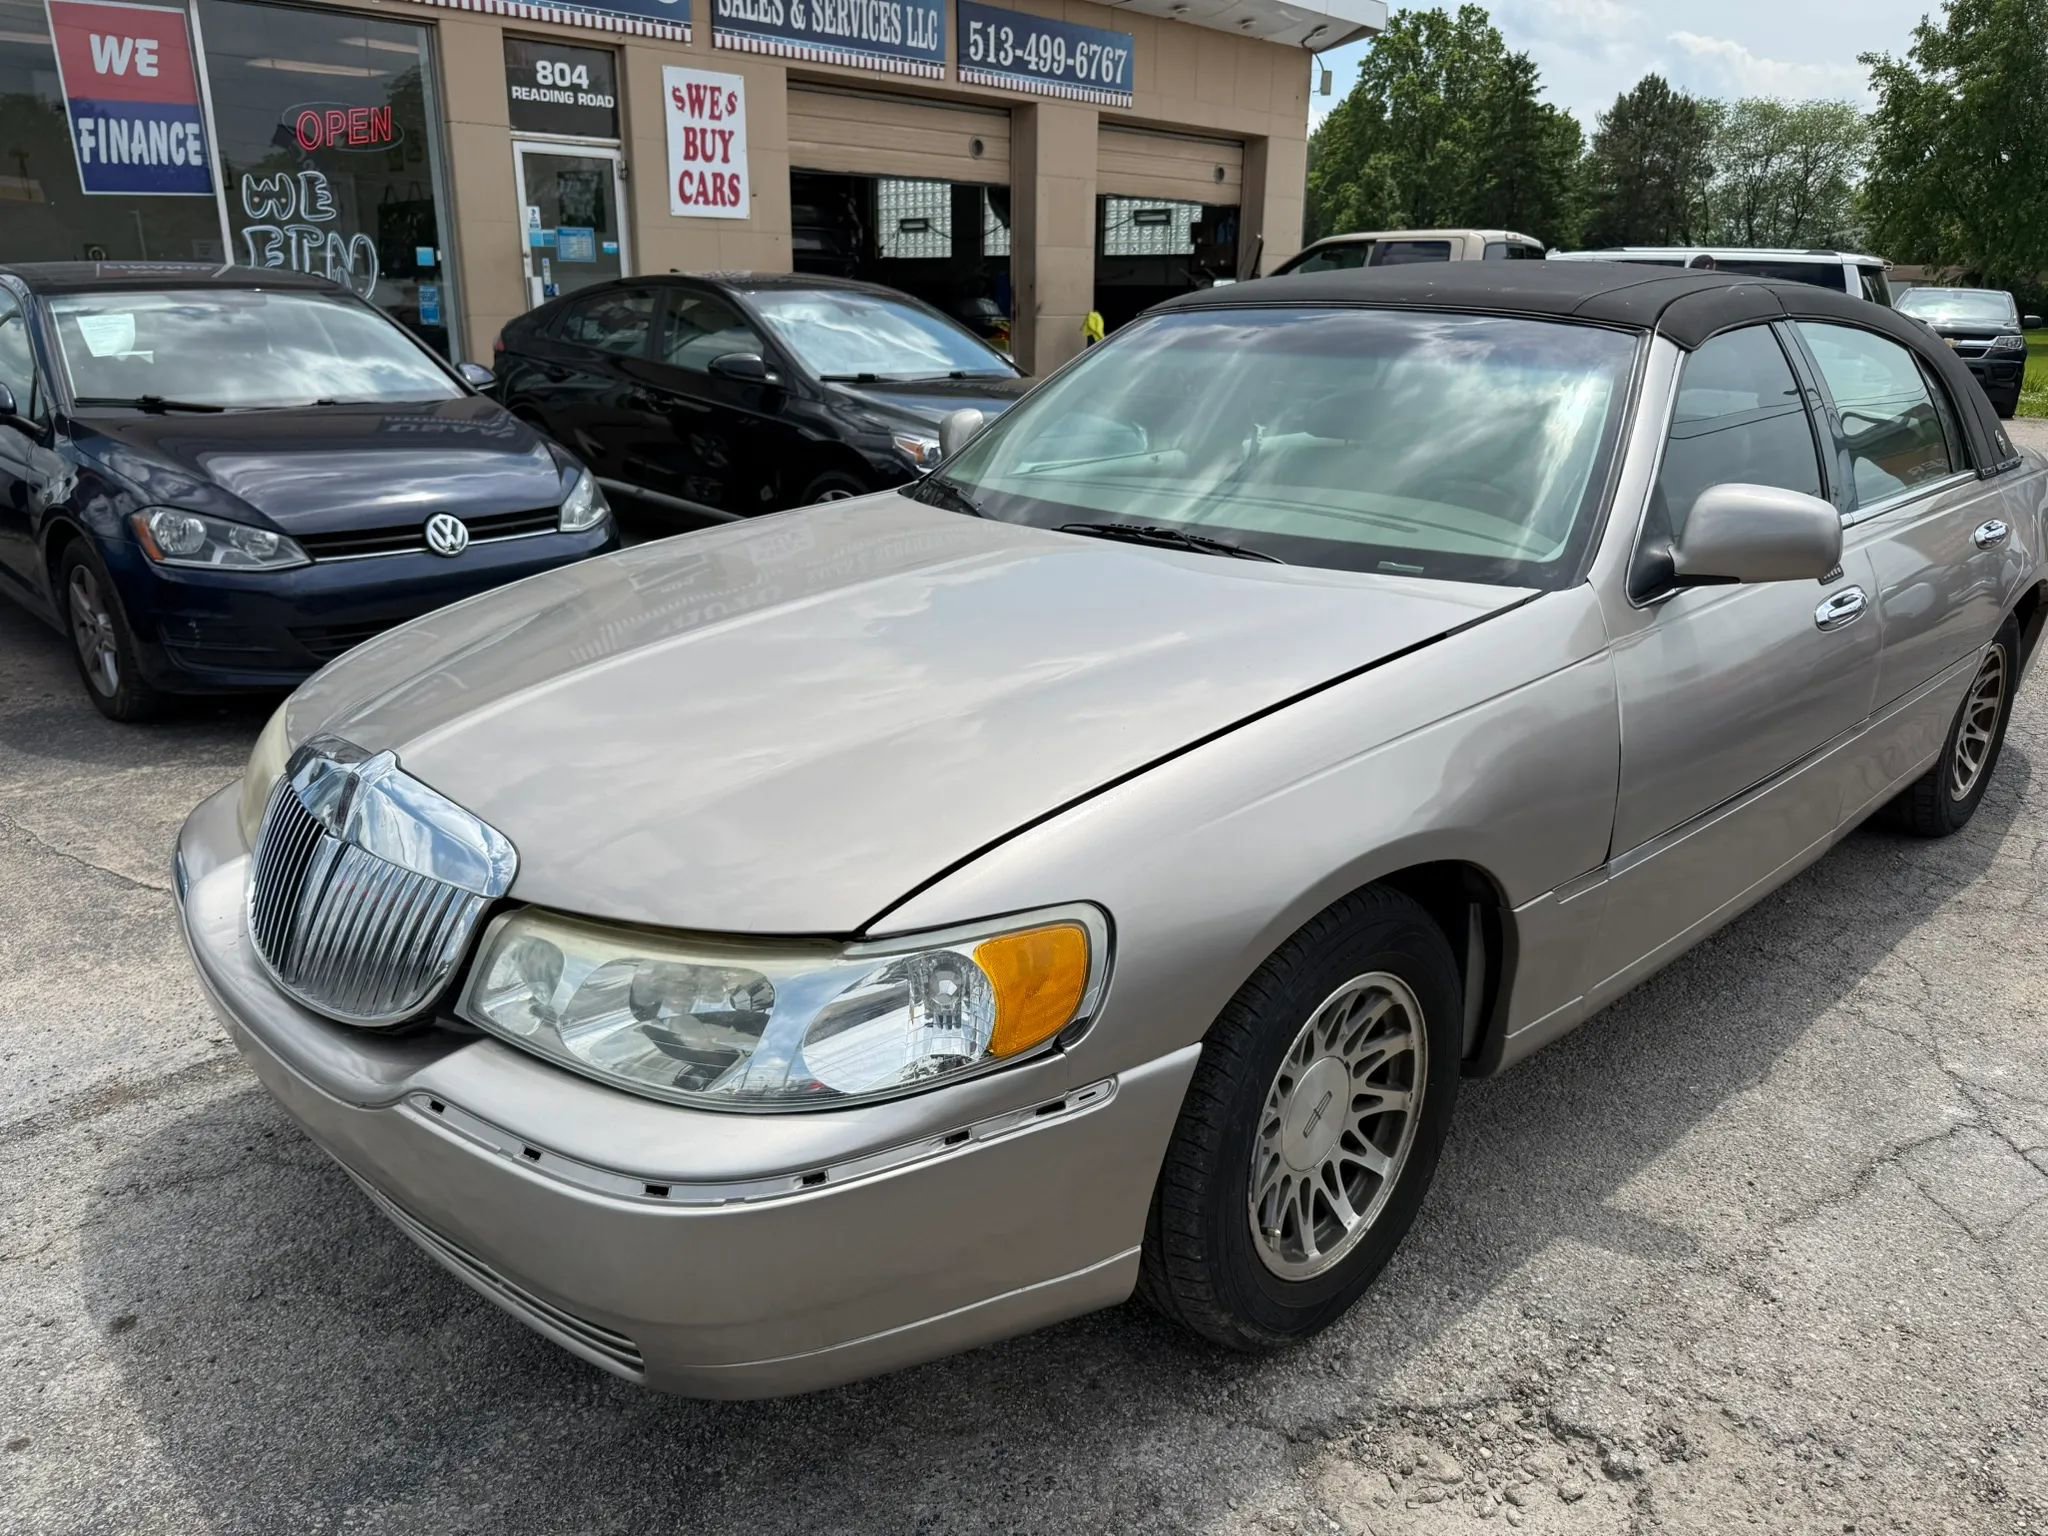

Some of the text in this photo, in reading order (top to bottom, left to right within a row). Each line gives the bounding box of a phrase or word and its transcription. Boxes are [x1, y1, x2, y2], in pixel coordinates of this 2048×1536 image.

[790, 0, 806, 29] &
[812, 0, 902, 46] SERVICES
[906, 6, 938, 51] LLC
[89, 33, 159, 77] WE
[535, 60, 590, 89] 804
[969, 20, 1127, 85] 513-499-6767
[511, 86, 615, 108] READING ROAD
[77, 117, 203, 166] FINANCE
[296, 105, 392, 151] OPEN
[683, 126, 734, 164] BUY
[242, 171, 337, 222] WE
[678, 169, 741, 207] CARS
